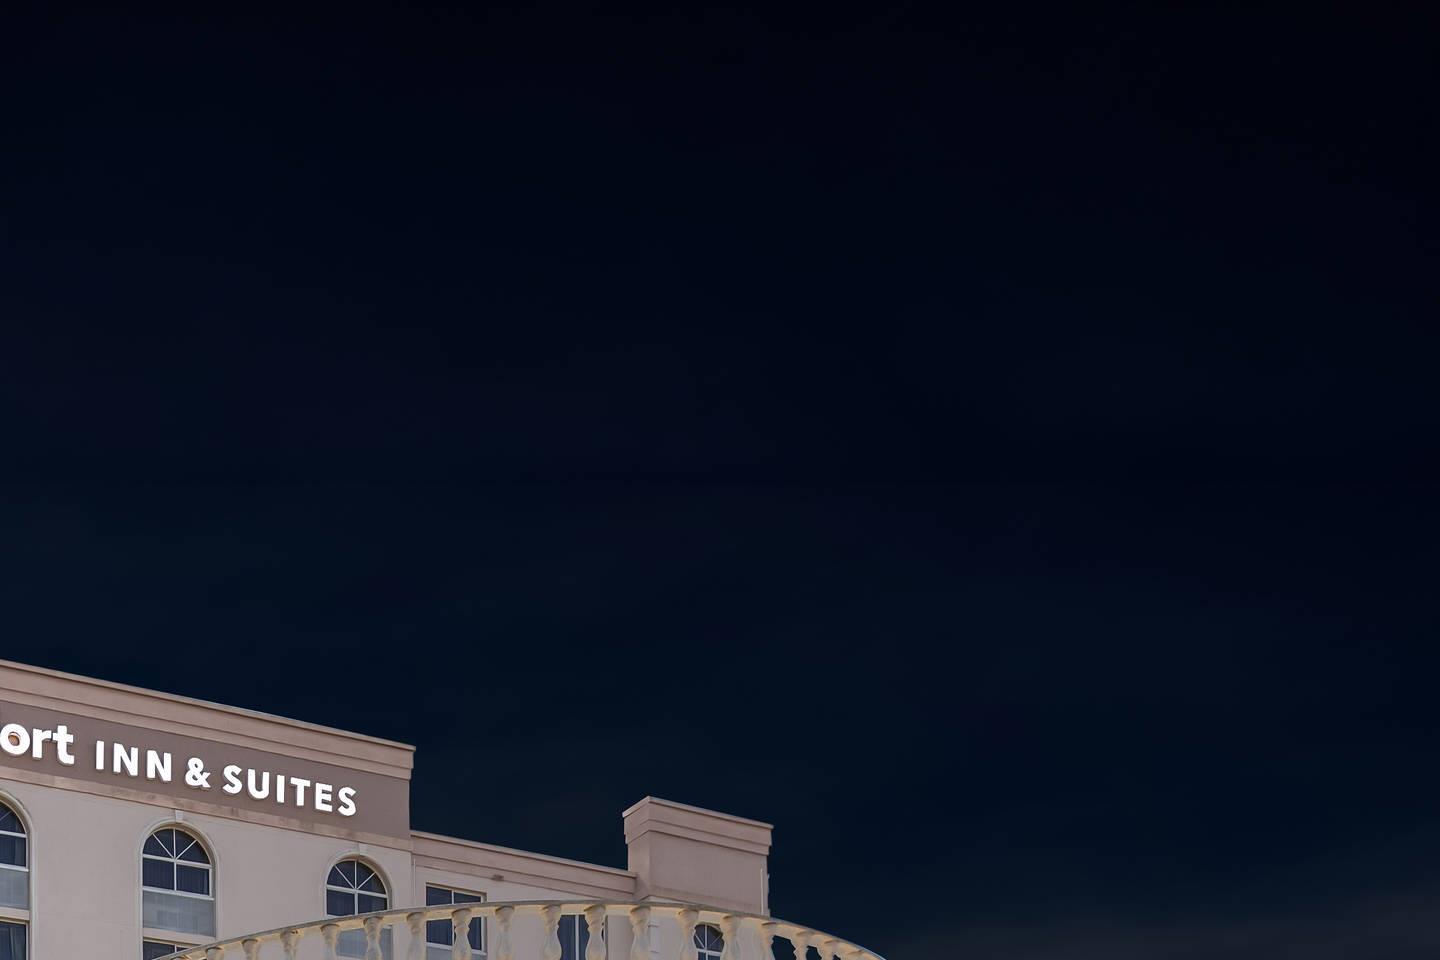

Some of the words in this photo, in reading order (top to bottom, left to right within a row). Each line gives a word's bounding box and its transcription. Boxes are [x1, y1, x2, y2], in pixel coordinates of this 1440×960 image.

[95, 739, 172, 782] INN
[185, 757, 211, 788] &
[222, 764, 357, 817] SUITES
